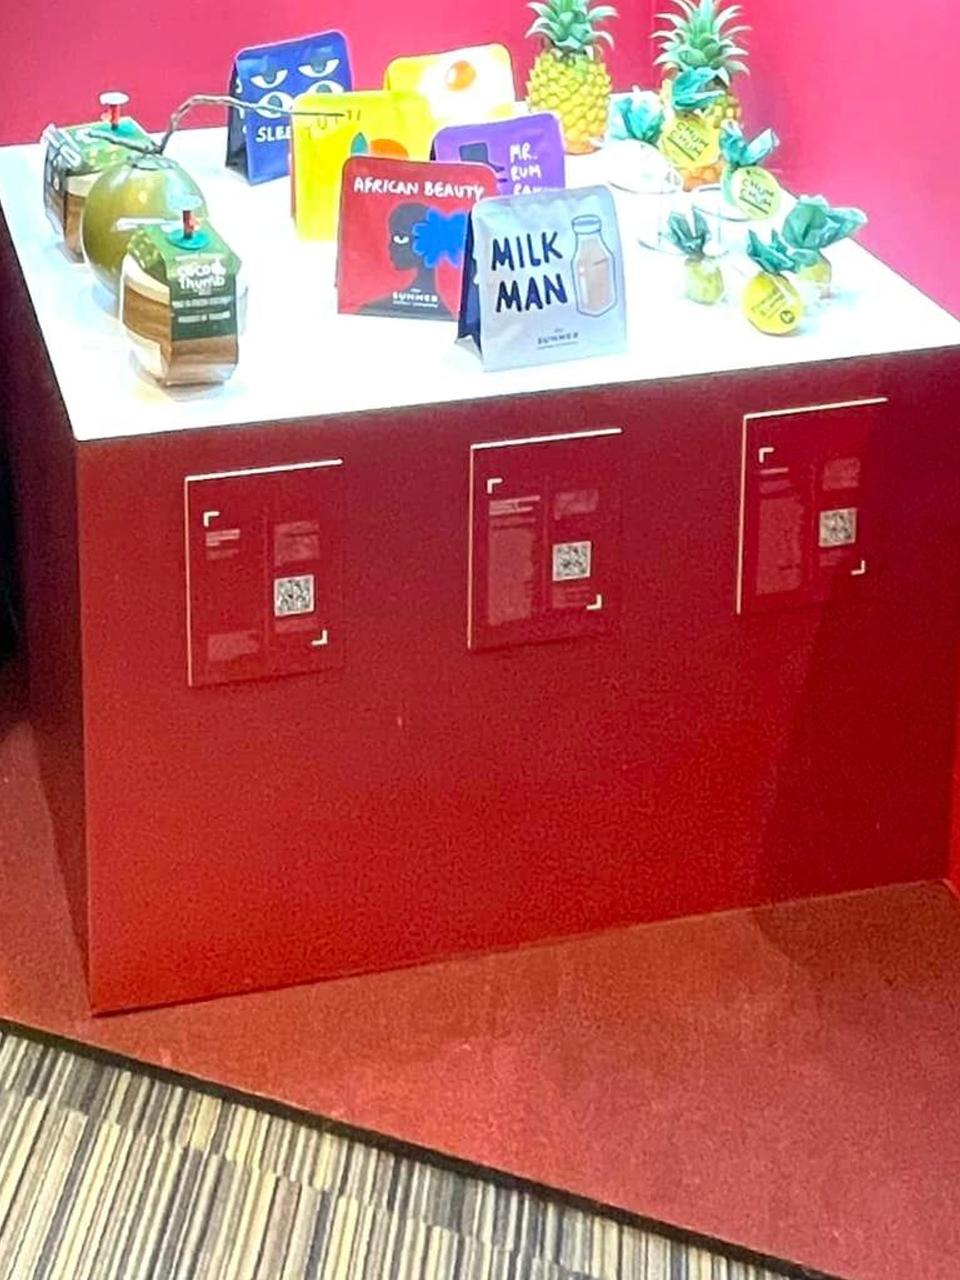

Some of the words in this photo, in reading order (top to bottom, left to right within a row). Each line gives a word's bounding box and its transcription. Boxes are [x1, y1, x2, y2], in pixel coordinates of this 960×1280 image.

[510, 164, 542, 182] RUM
[353, 176, 419, 195] AFRICAN
[423, 180, 485, 200] BEAUTY
[741, 177, 775, 198] CHUM
[490, 231, 563, 271] MILK
[496, 273, 568, 313] MAN
